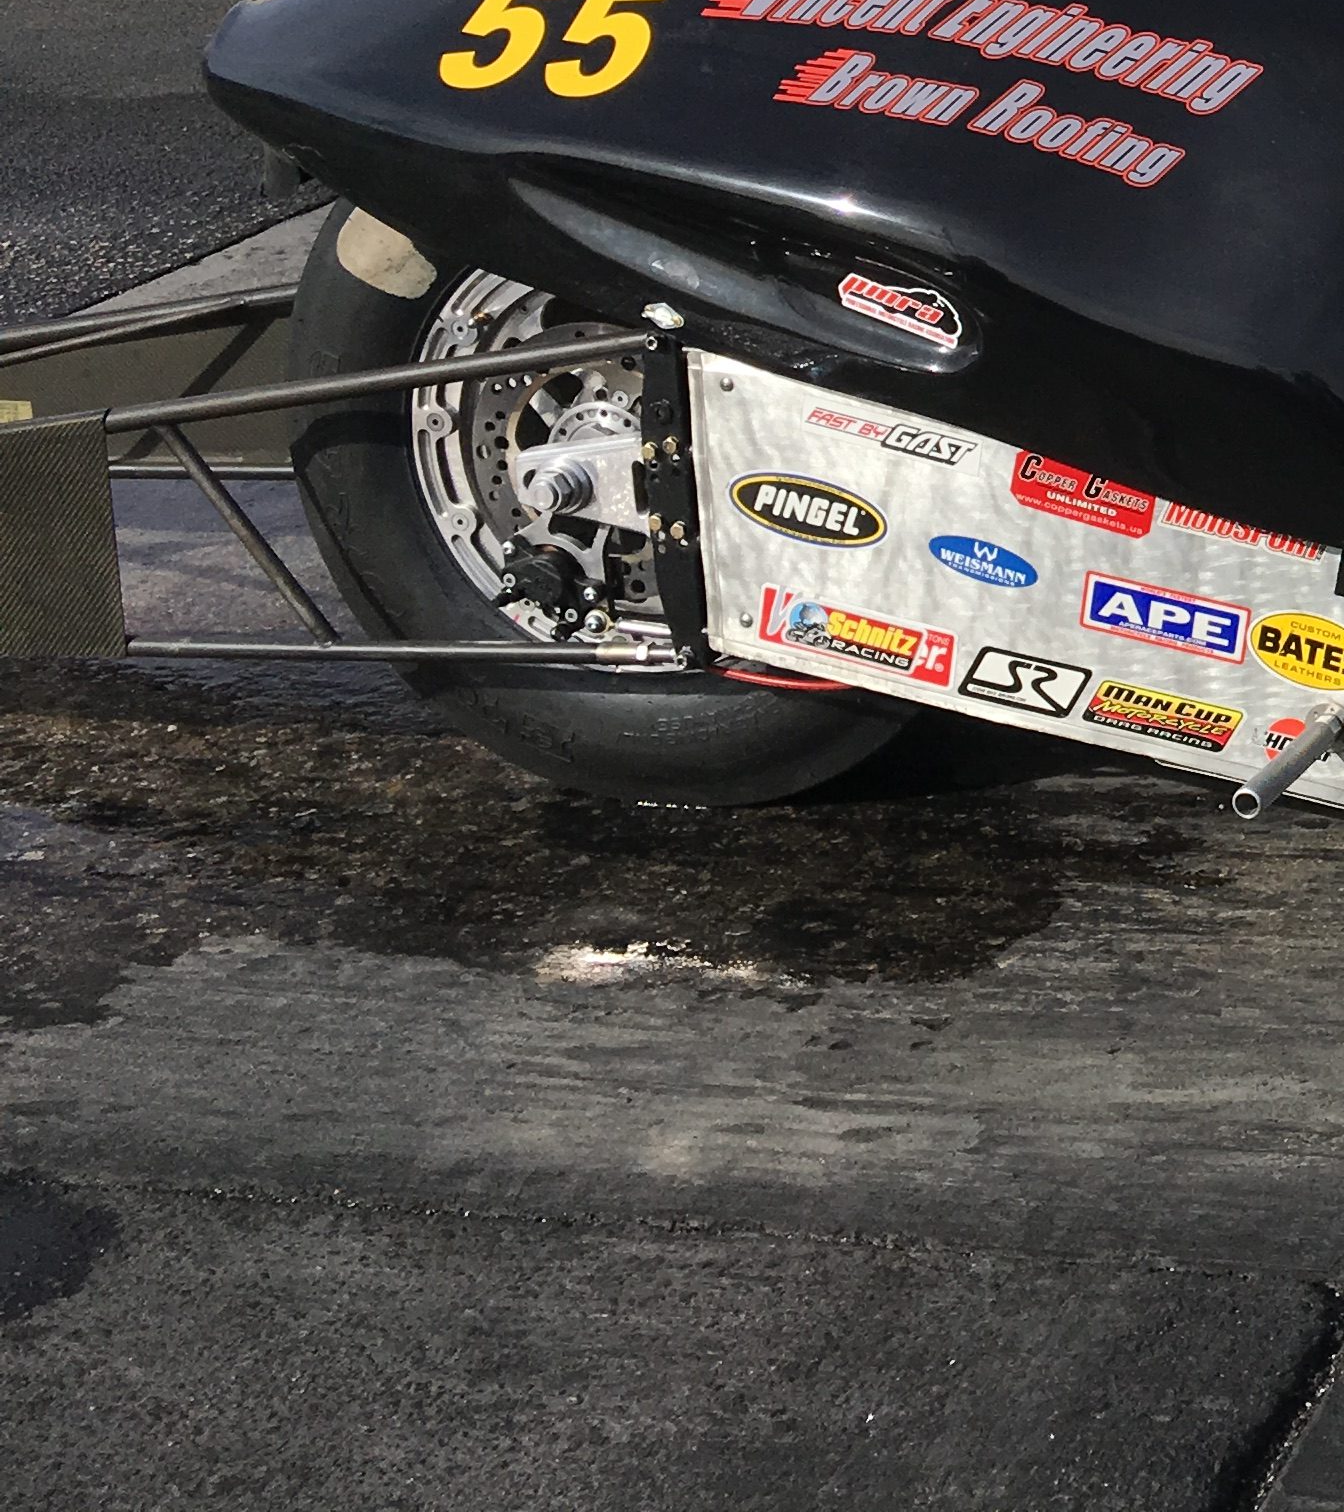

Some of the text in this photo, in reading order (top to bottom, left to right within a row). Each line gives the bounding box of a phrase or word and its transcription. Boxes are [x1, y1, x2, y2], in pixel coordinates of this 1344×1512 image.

[803, 50, 1186, 187] Brown Roofing
[807, 409, 978, 465] FAST BY GAST
[1018, 453, 1150, 513] COPPER GASKETS
[1046, 490, 1118, 517] UNLIMITED
[753, 484, 860, 536] PINGEL
[1015, 492, 1143, 535] www.coppergaskets.us
[940, 547, 1027, 585] WEISMANN
[826, 610, 918, 656] Schnitz
[1098, 591, 1232, 647] APE
[1290, 620, 1341, 641] CUSTOM
[830, 639, 910, 667] RACING
[1273, 659, 1341, 686] LEATHERS
[1093, 699, 1229, 736] MOTORCYCLE
[1102, 684, 1233, 725] MAN CUP
[1093, 715, 1213, 748] DRAG RACING
